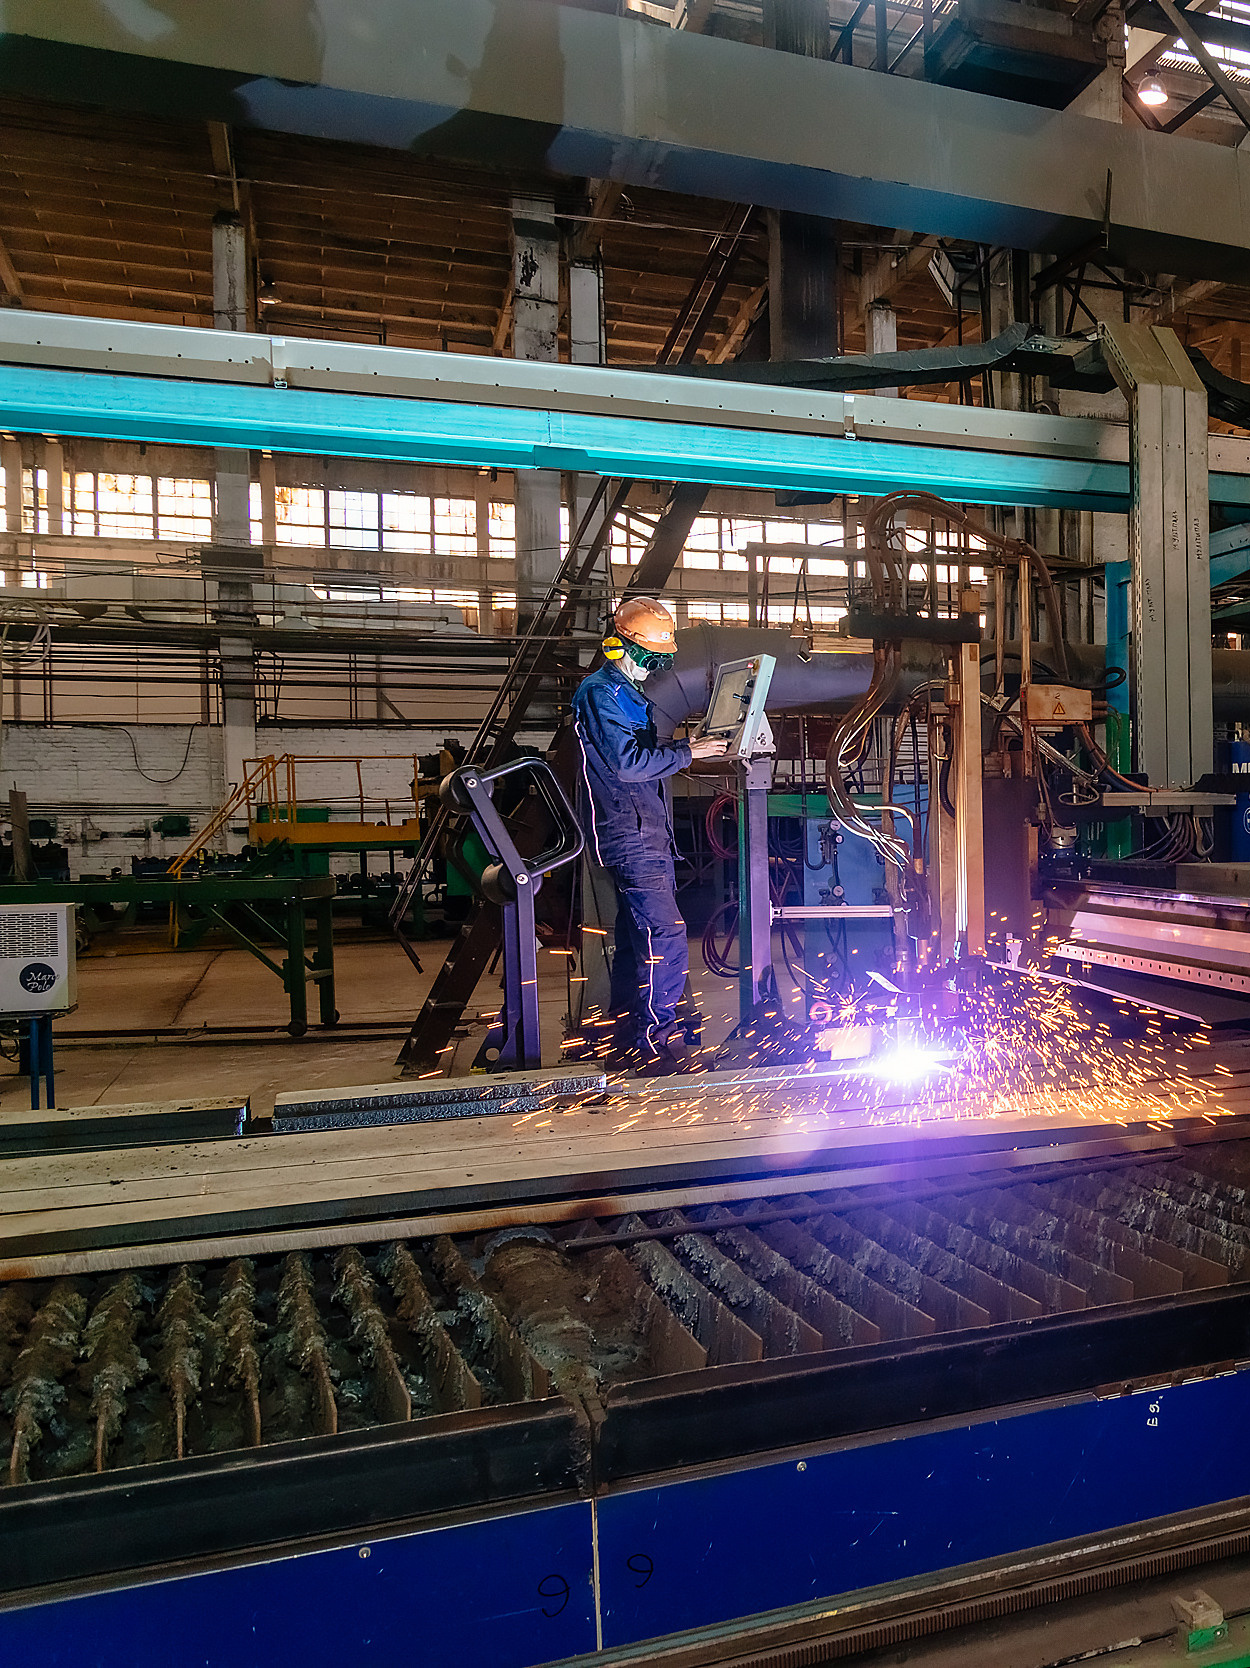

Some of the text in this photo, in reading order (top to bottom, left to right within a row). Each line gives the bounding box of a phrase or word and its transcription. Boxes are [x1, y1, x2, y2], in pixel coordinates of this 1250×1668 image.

[26, 971, 60, 982] Marco
[27, 980, 51, 992] Polo
[627, 1553, 653, 1588] 9
[537, 1574, 571, 1618] 9
